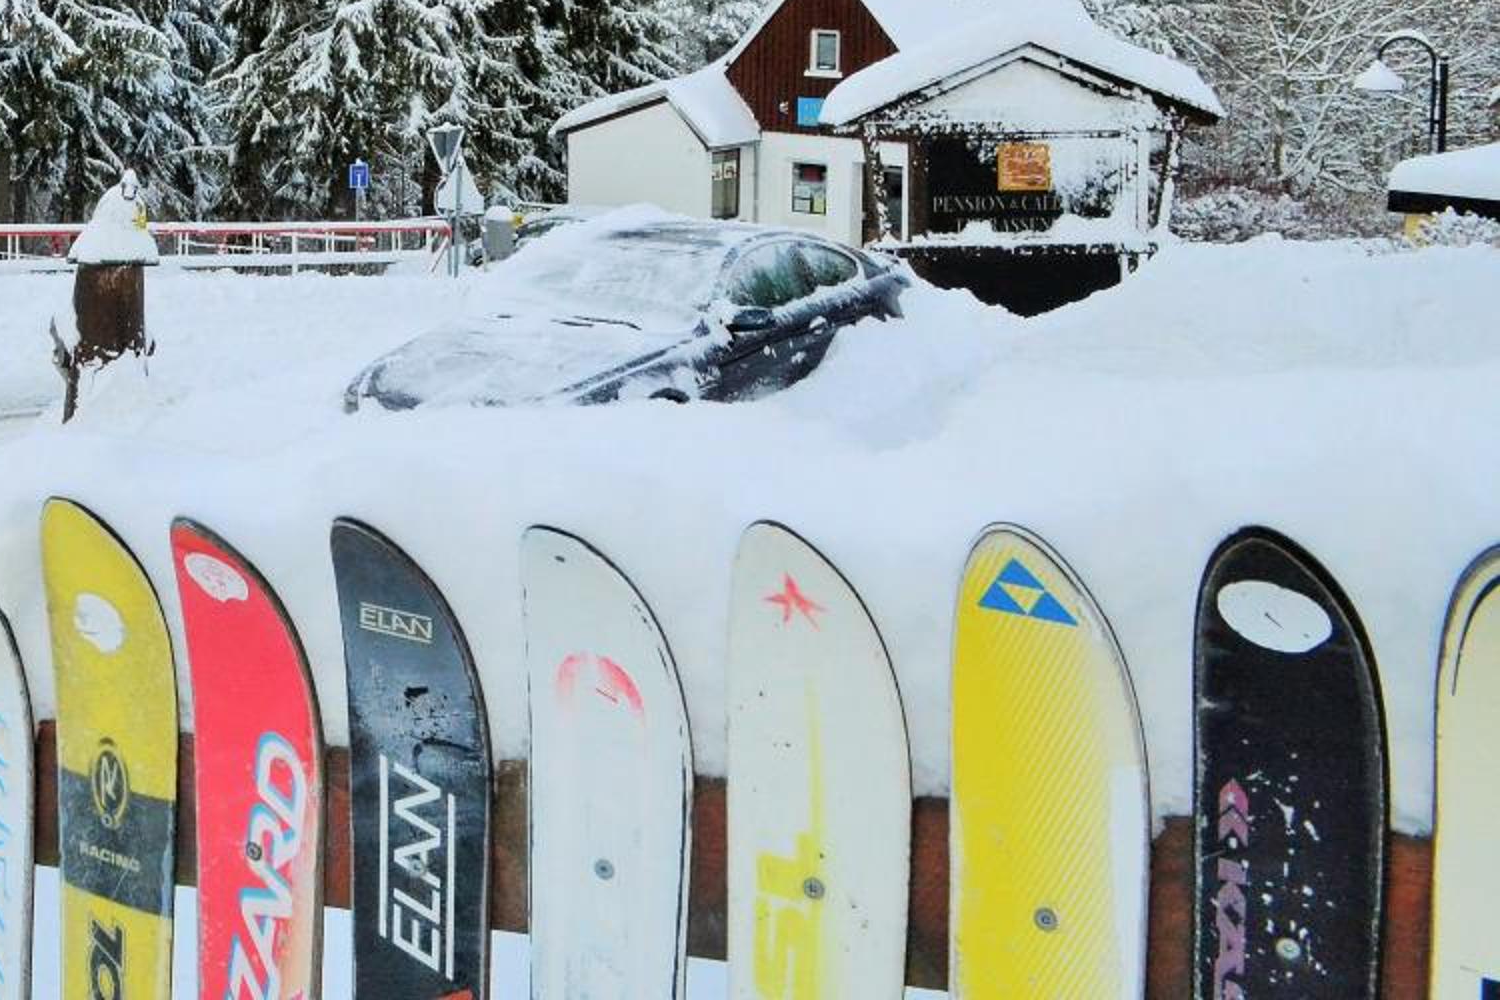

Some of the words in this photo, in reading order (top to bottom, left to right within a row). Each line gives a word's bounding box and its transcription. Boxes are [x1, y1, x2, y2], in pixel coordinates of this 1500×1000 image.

[932, 195, 1006, 213] PENSION
[359, 606, 433, 640] ELAN
[78, 841, 141, 873] RACING
[393, 762, 441, 973] ELAN
